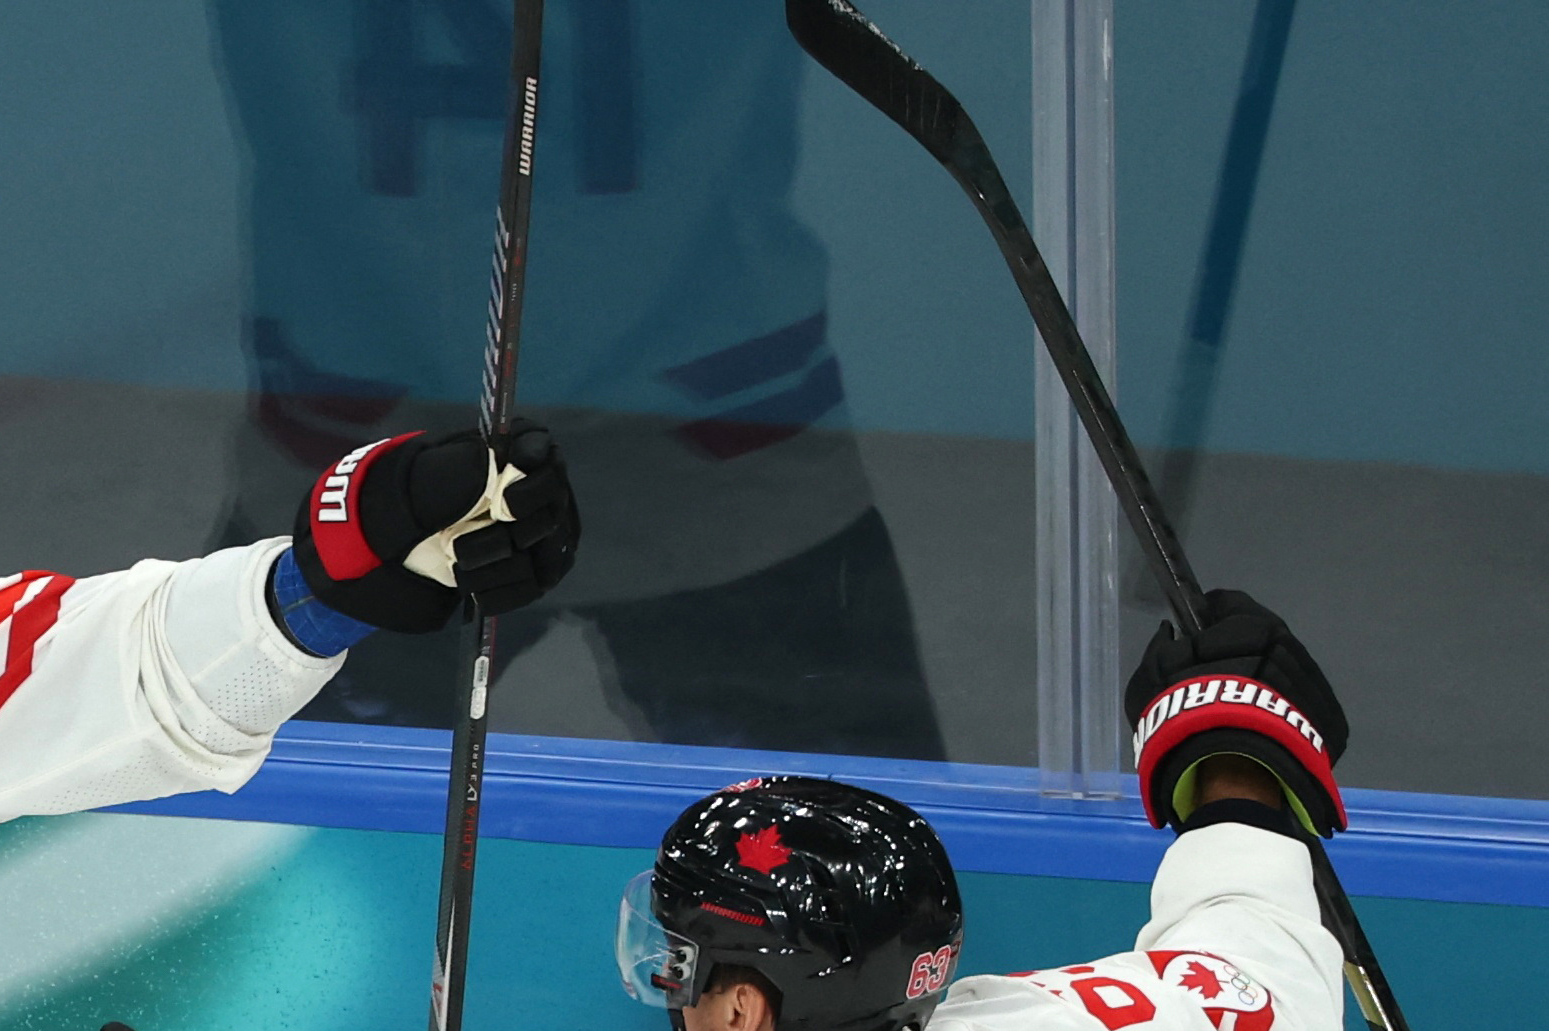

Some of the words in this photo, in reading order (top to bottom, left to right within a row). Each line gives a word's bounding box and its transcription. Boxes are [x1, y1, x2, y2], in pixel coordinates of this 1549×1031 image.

[519, 77, 537, 176] WARRIOR
[318, 438, 391, 521] WA
[1132, 679, 1325, 770] WARRIOR
[461, 805, 477, 871] ALPHA
[906, 944, 951, 1000] 63
